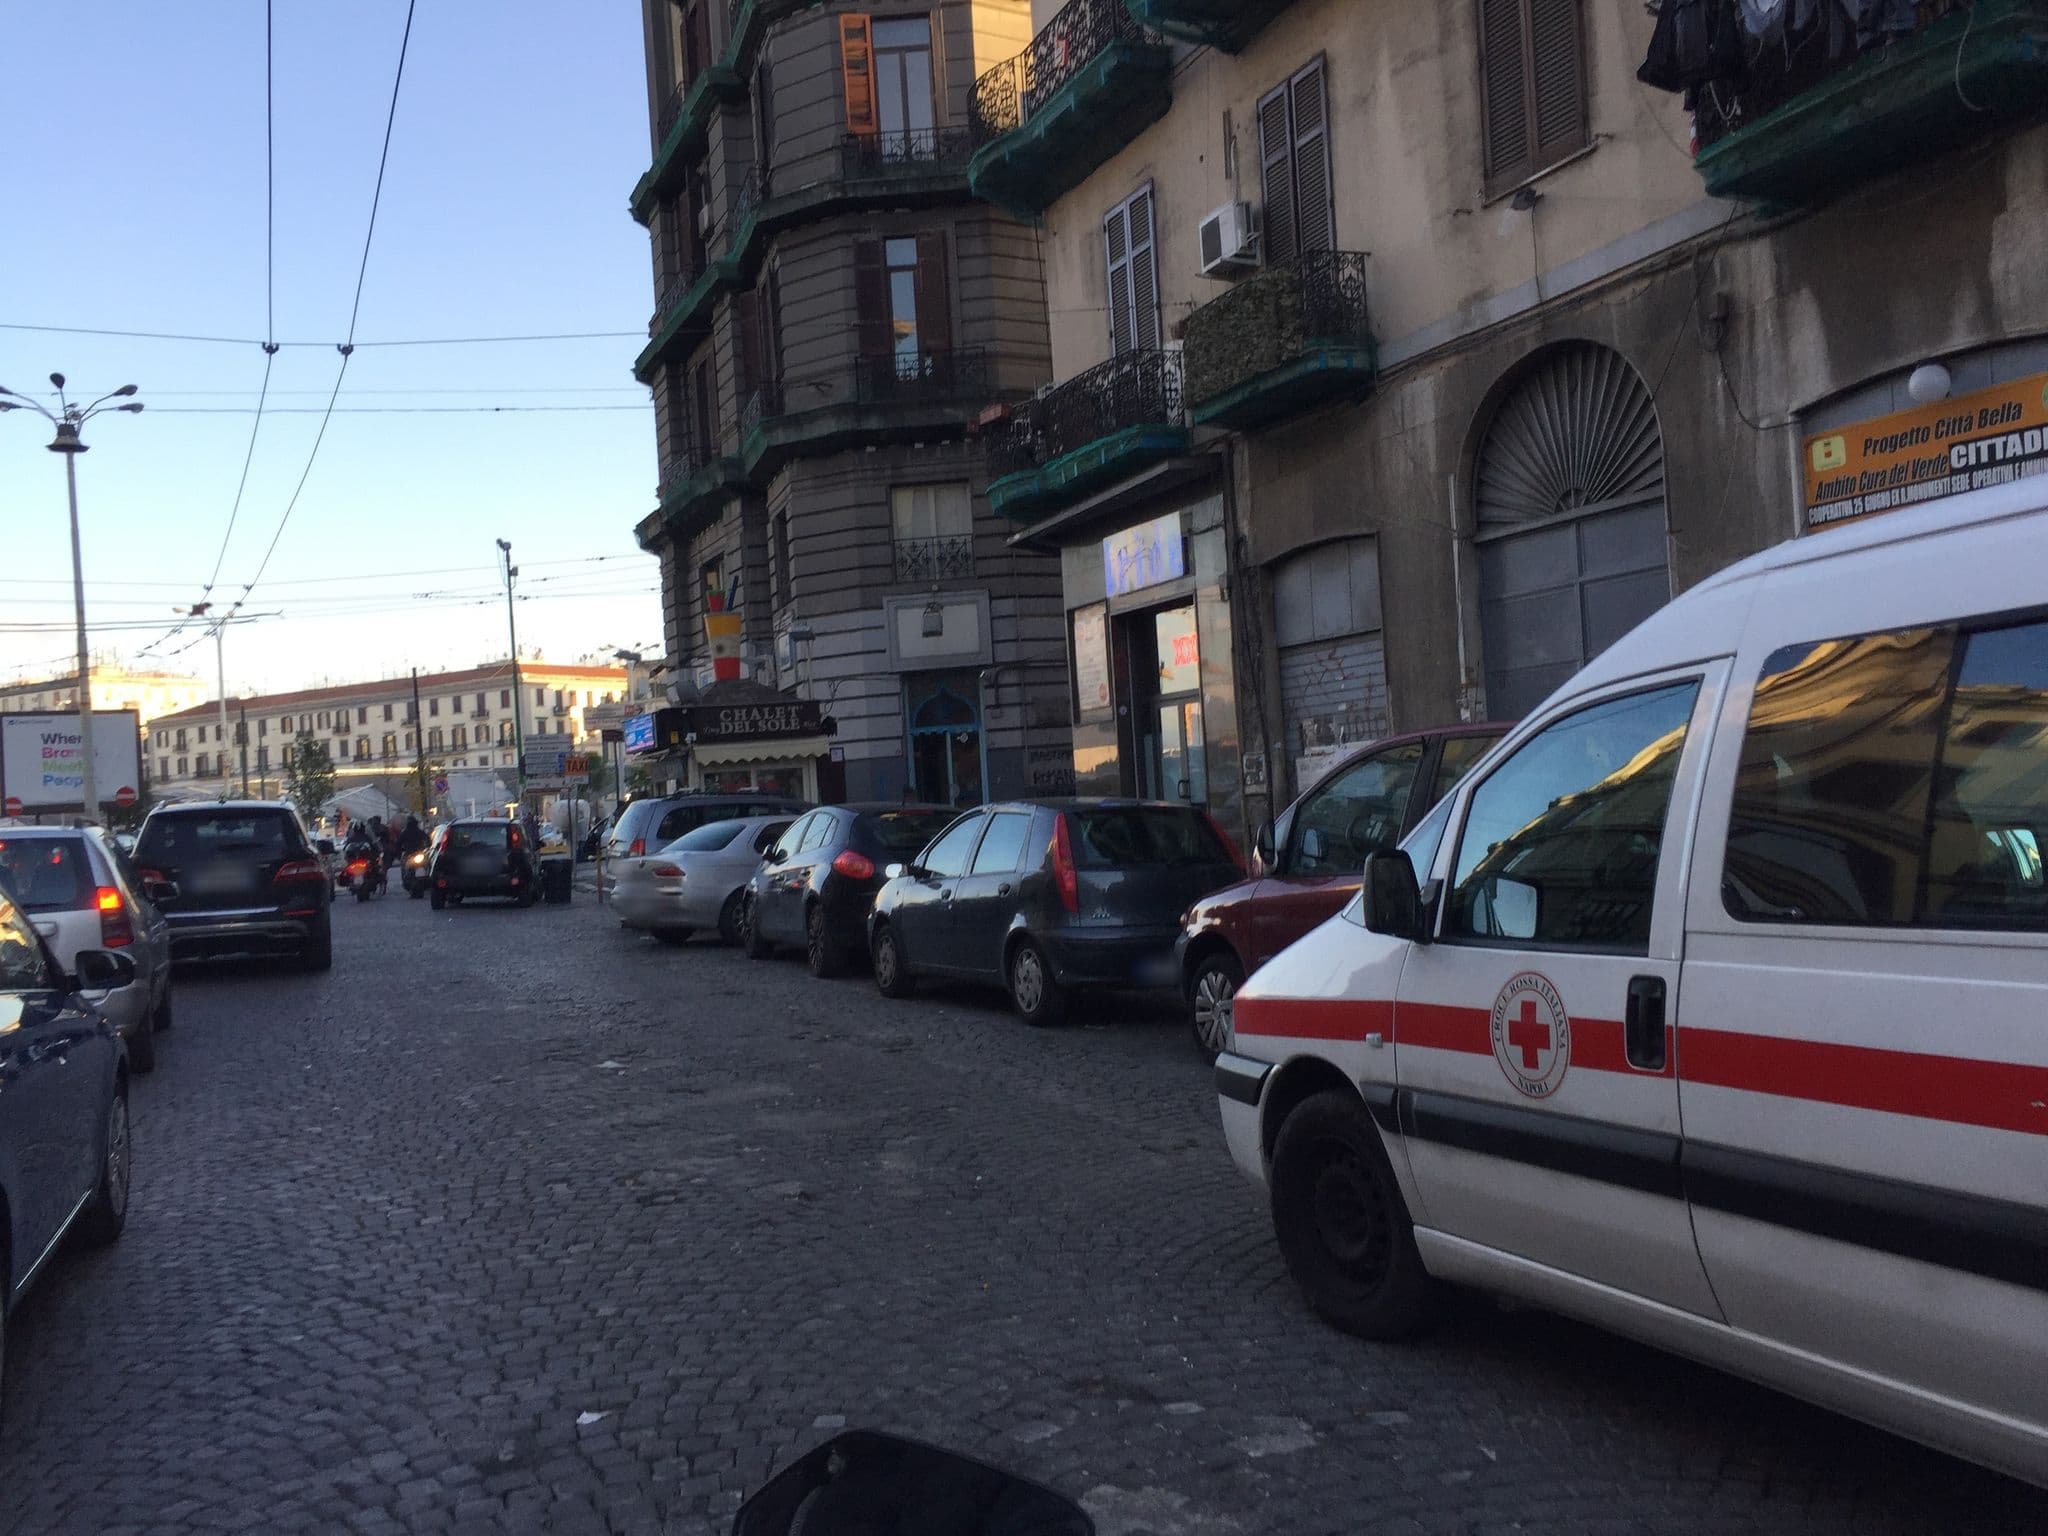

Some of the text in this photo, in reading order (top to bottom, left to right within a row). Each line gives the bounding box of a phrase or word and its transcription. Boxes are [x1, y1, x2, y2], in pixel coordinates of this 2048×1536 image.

[1862, 426, 1931, 457] Progetto
[1977, 400, 2023, 429] Bella
[1815, 453, 1948, 502] Ambito Cura del Verde
[1808, 499, 1853, 525] COOPERATIVA
[1853, 496, 1863, 515] 25
[1951, 472, 1970, 493] SEDE
[1972, 464, 2014, 489] OPERATIVA
[40, 732, 82, 745] Wher
[720, 720, 755, 734] DEL
[758, 718, 800, 732] SOLE
[566, 757, 589, 772] TAXI
[1510, 976, 1539, 995] ROSSA
[1541, 983, 1566, 1050] ITALIANA
[1518, 1077, 1549, 1094] NAPOLI
